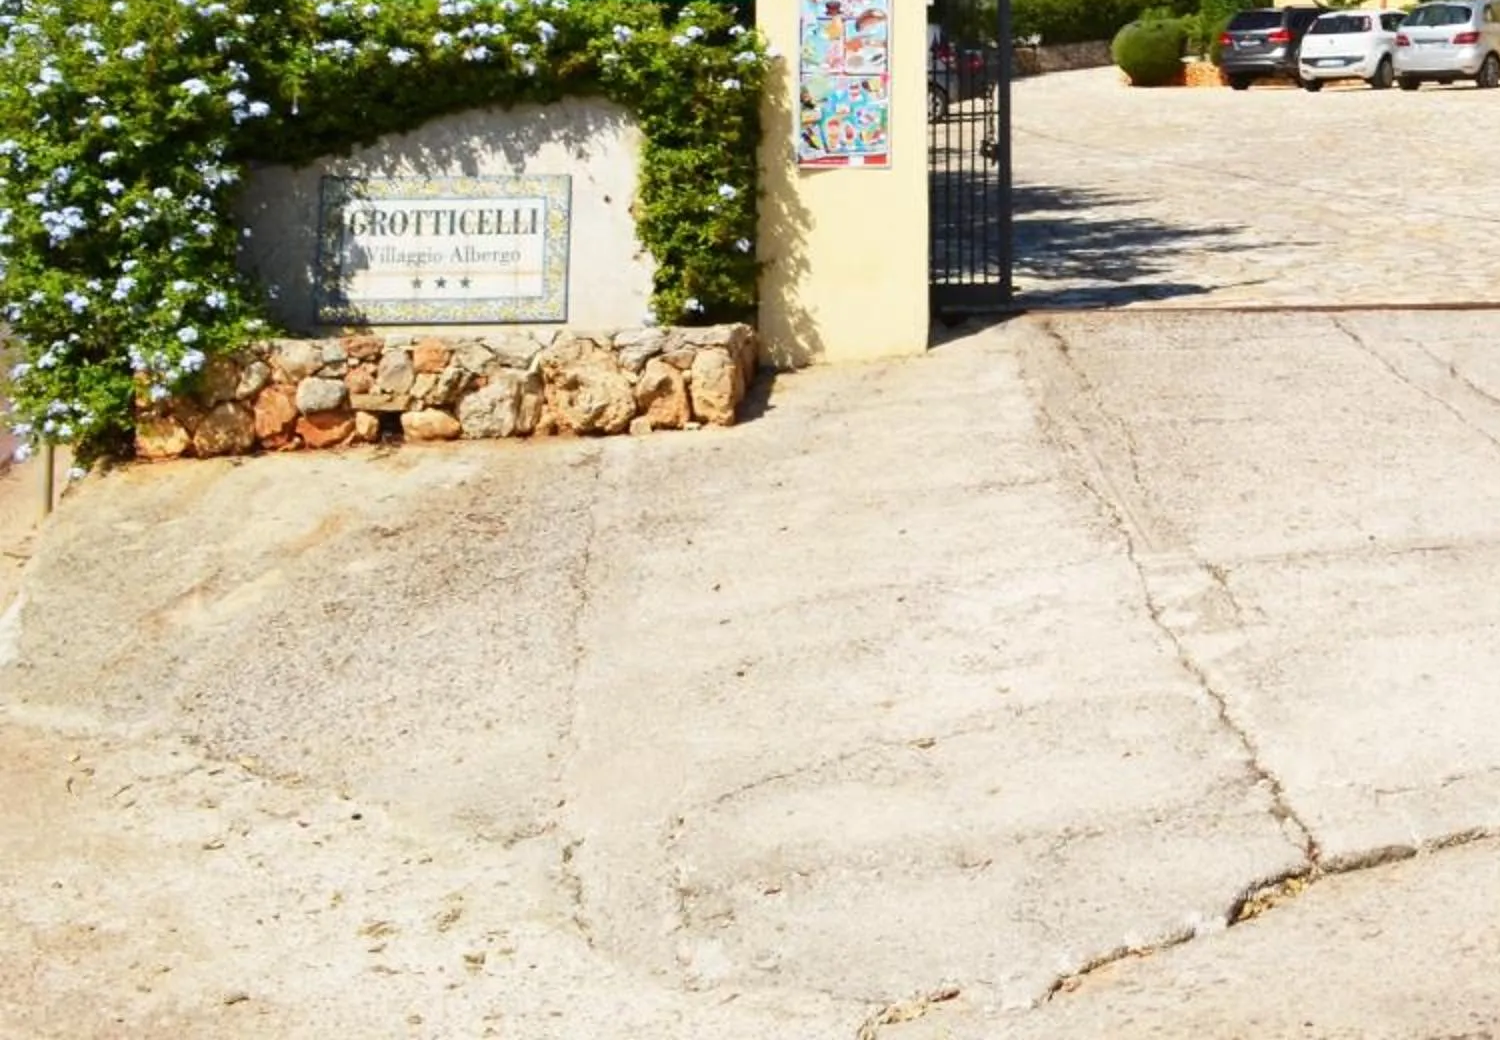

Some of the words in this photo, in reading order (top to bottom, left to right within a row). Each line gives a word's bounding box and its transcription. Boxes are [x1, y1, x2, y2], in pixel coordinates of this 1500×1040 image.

[350, 207, 540, 236] GROTTICELLI
[367, 244, 442, 266] Villaggio
[450, 245, 521, 264] Albergo
